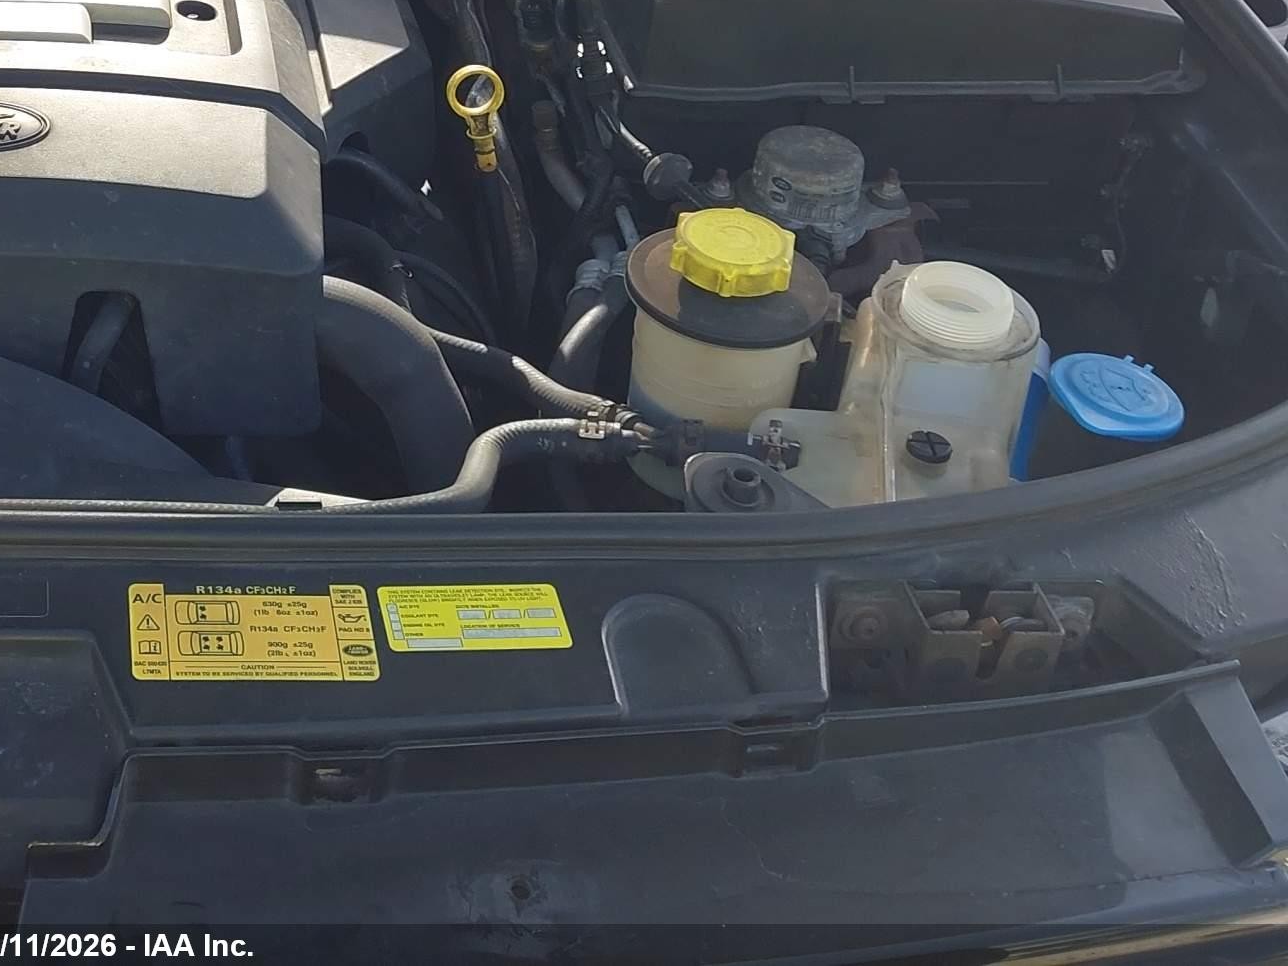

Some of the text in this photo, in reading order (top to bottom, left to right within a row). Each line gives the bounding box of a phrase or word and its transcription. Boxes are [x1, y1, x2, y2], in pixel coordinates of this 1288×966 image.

[196, 586, 242, 594] R134a
[132, 593, 162, 603] A/C
[262, 601, 282, 609] 630g
[267, 641, 288, 649] 900g
